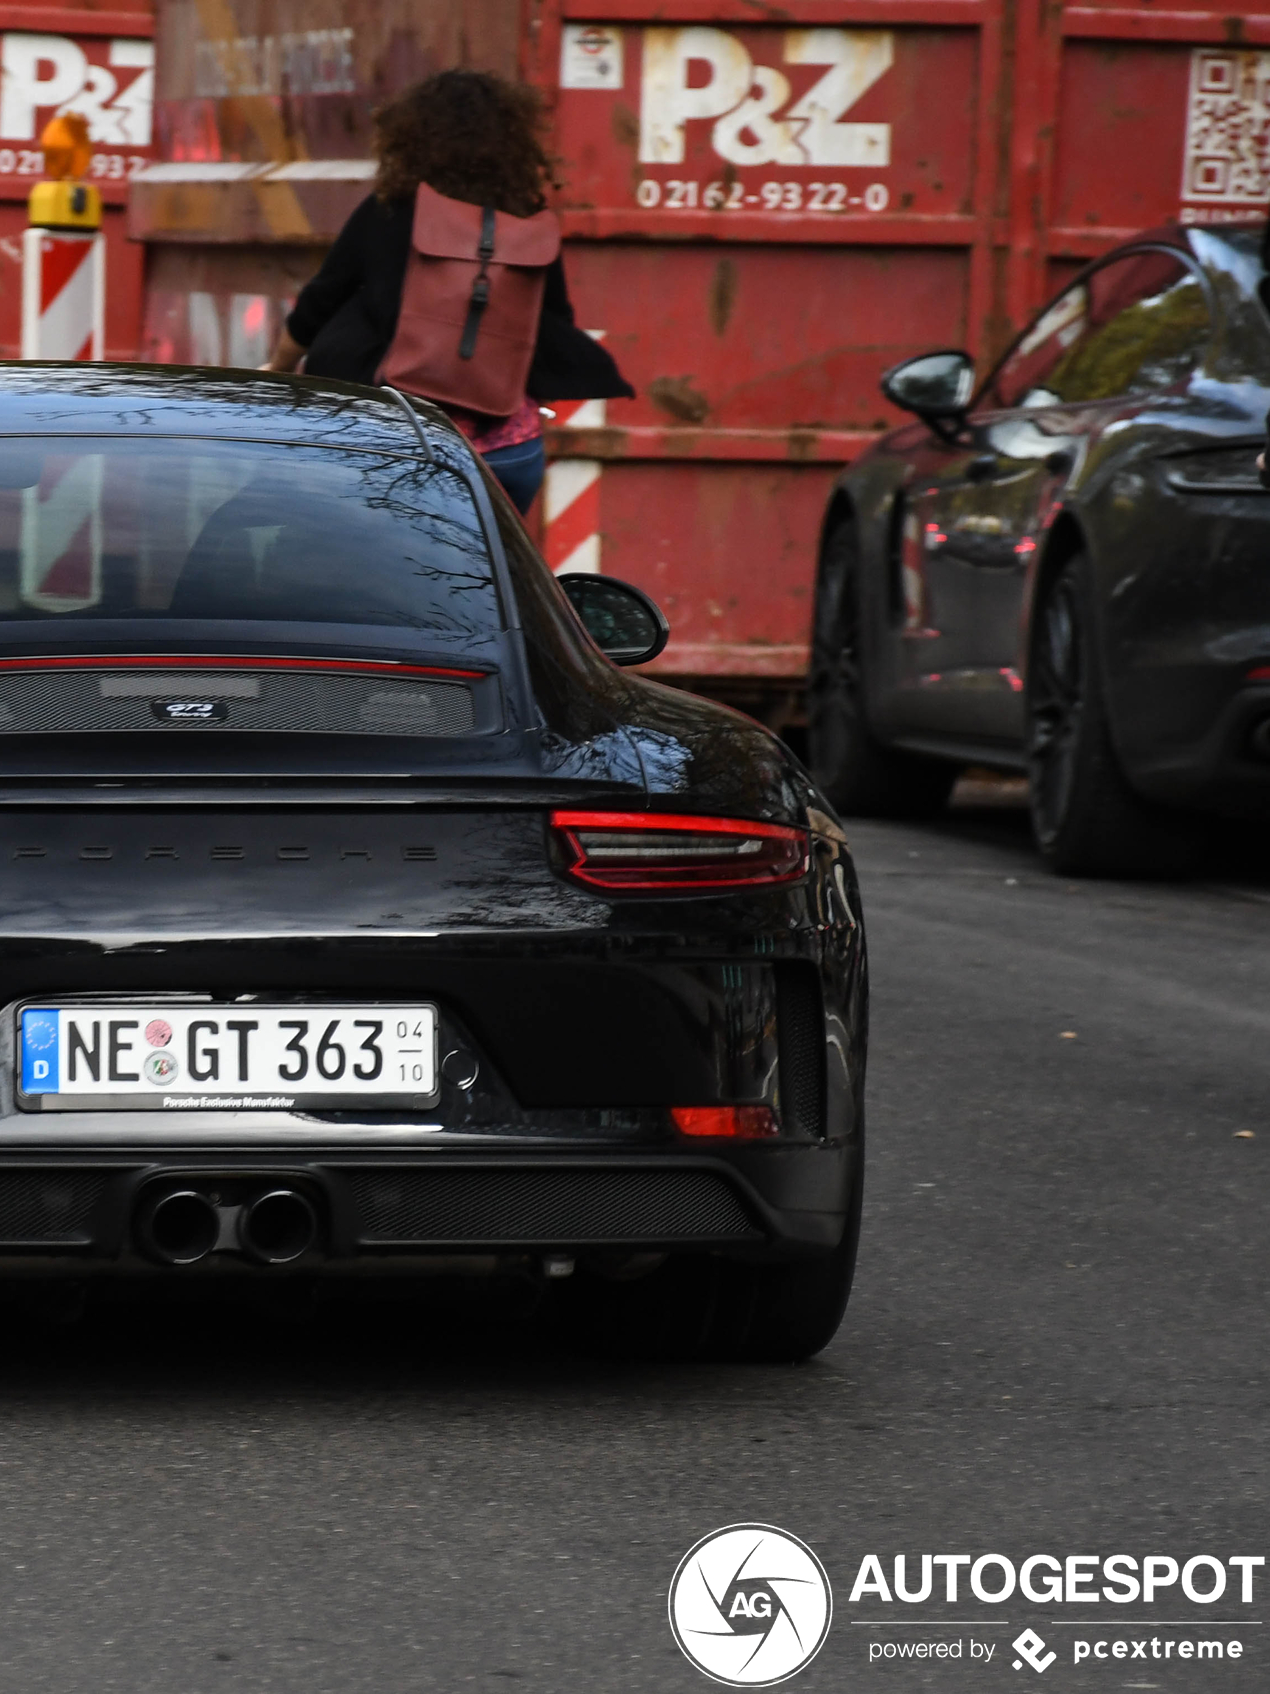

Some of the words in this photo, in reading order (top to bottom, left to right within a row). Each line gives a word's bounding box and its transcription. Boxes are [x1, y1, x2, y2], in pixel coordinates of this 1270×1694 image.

[639, 25, 893, 166] P&Z
[13, 845, 438, 861] PORSCHE
[397, 1021, 422, 1038] 04
[34, 1060, 48, 1078] D
[69, 1021, 139, 1081] NE
[188, 1021, 258, 1081] GT
[279, 1020, 382, 1081] 363
[400, 1064, 422, 1081] 10
